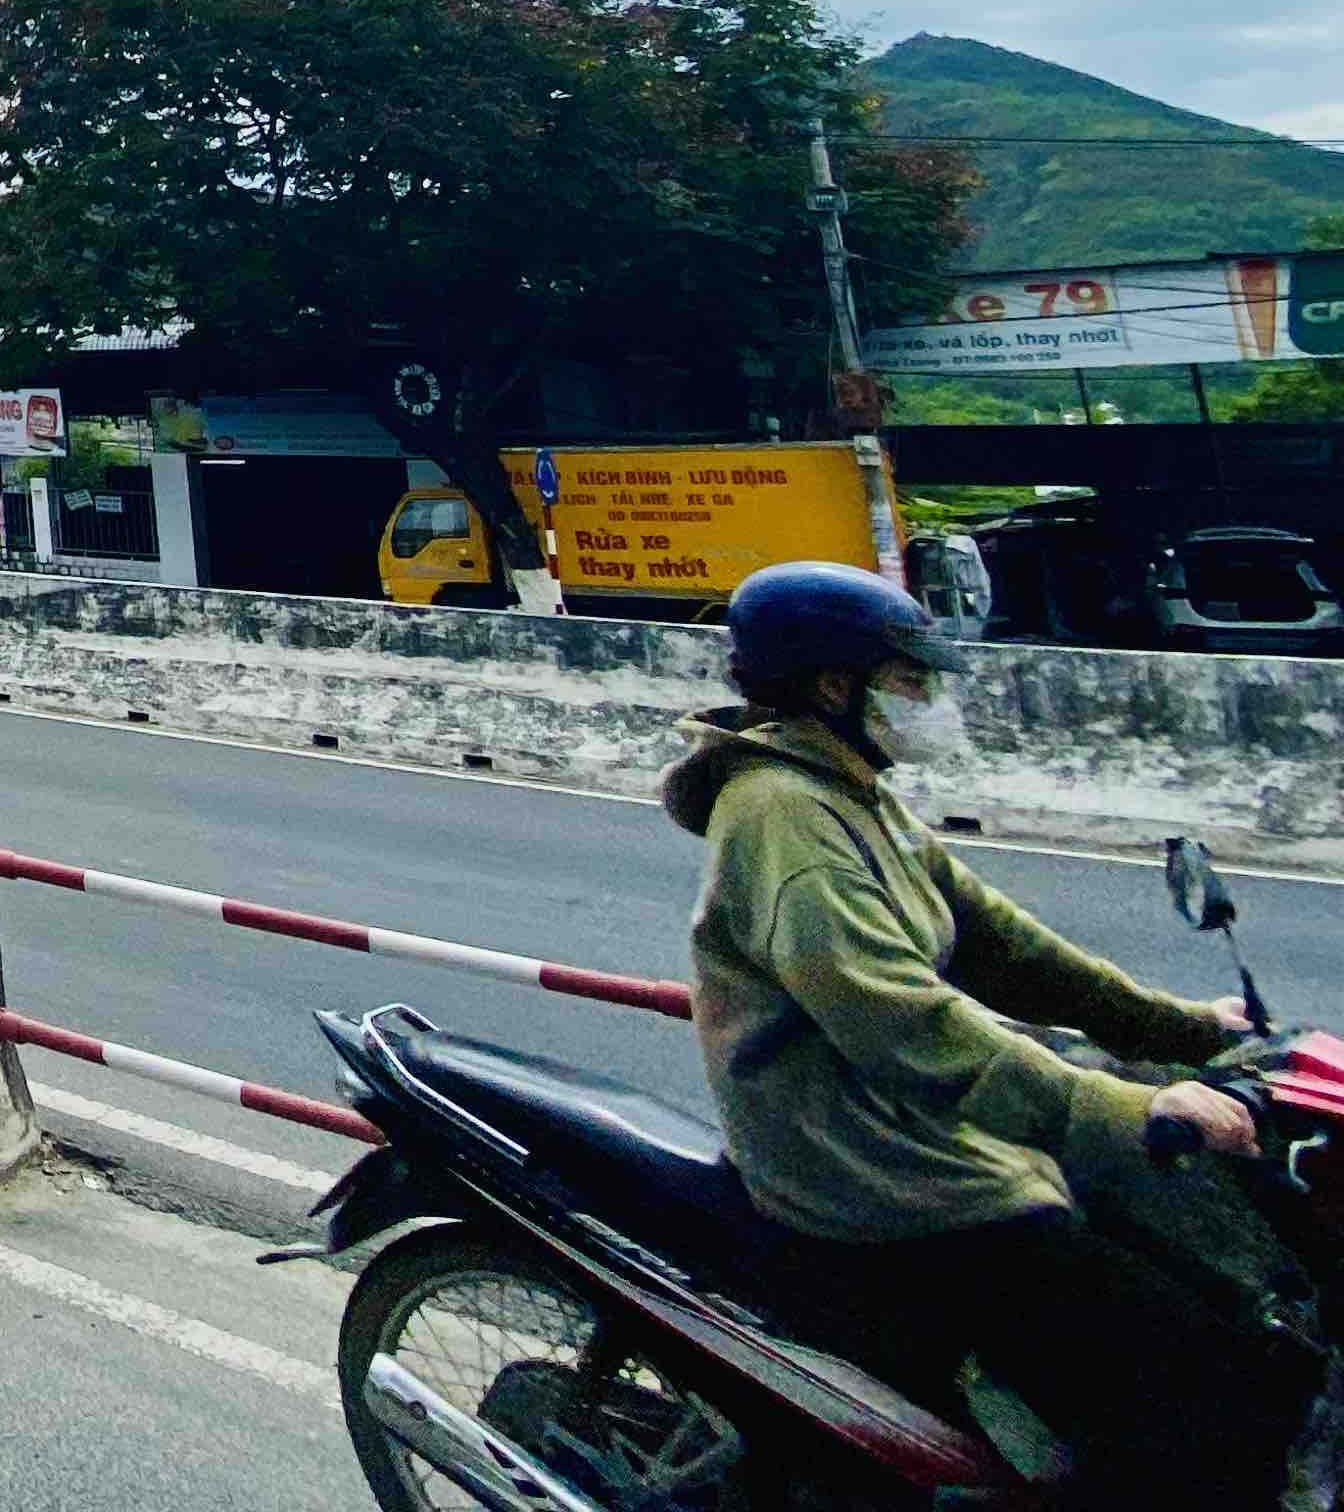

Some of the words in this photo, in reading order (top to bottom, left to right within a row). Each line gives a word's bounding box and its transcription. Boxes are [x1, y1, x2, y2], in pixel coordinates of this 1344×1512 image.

[1023, 279, 1107, 318] 79
[1015, 332, 1061, 349] thay
[574, 528, 628, 551] Rửa
[640, 533, 671, 551] xe
[578, 556, 635, 580] thay
